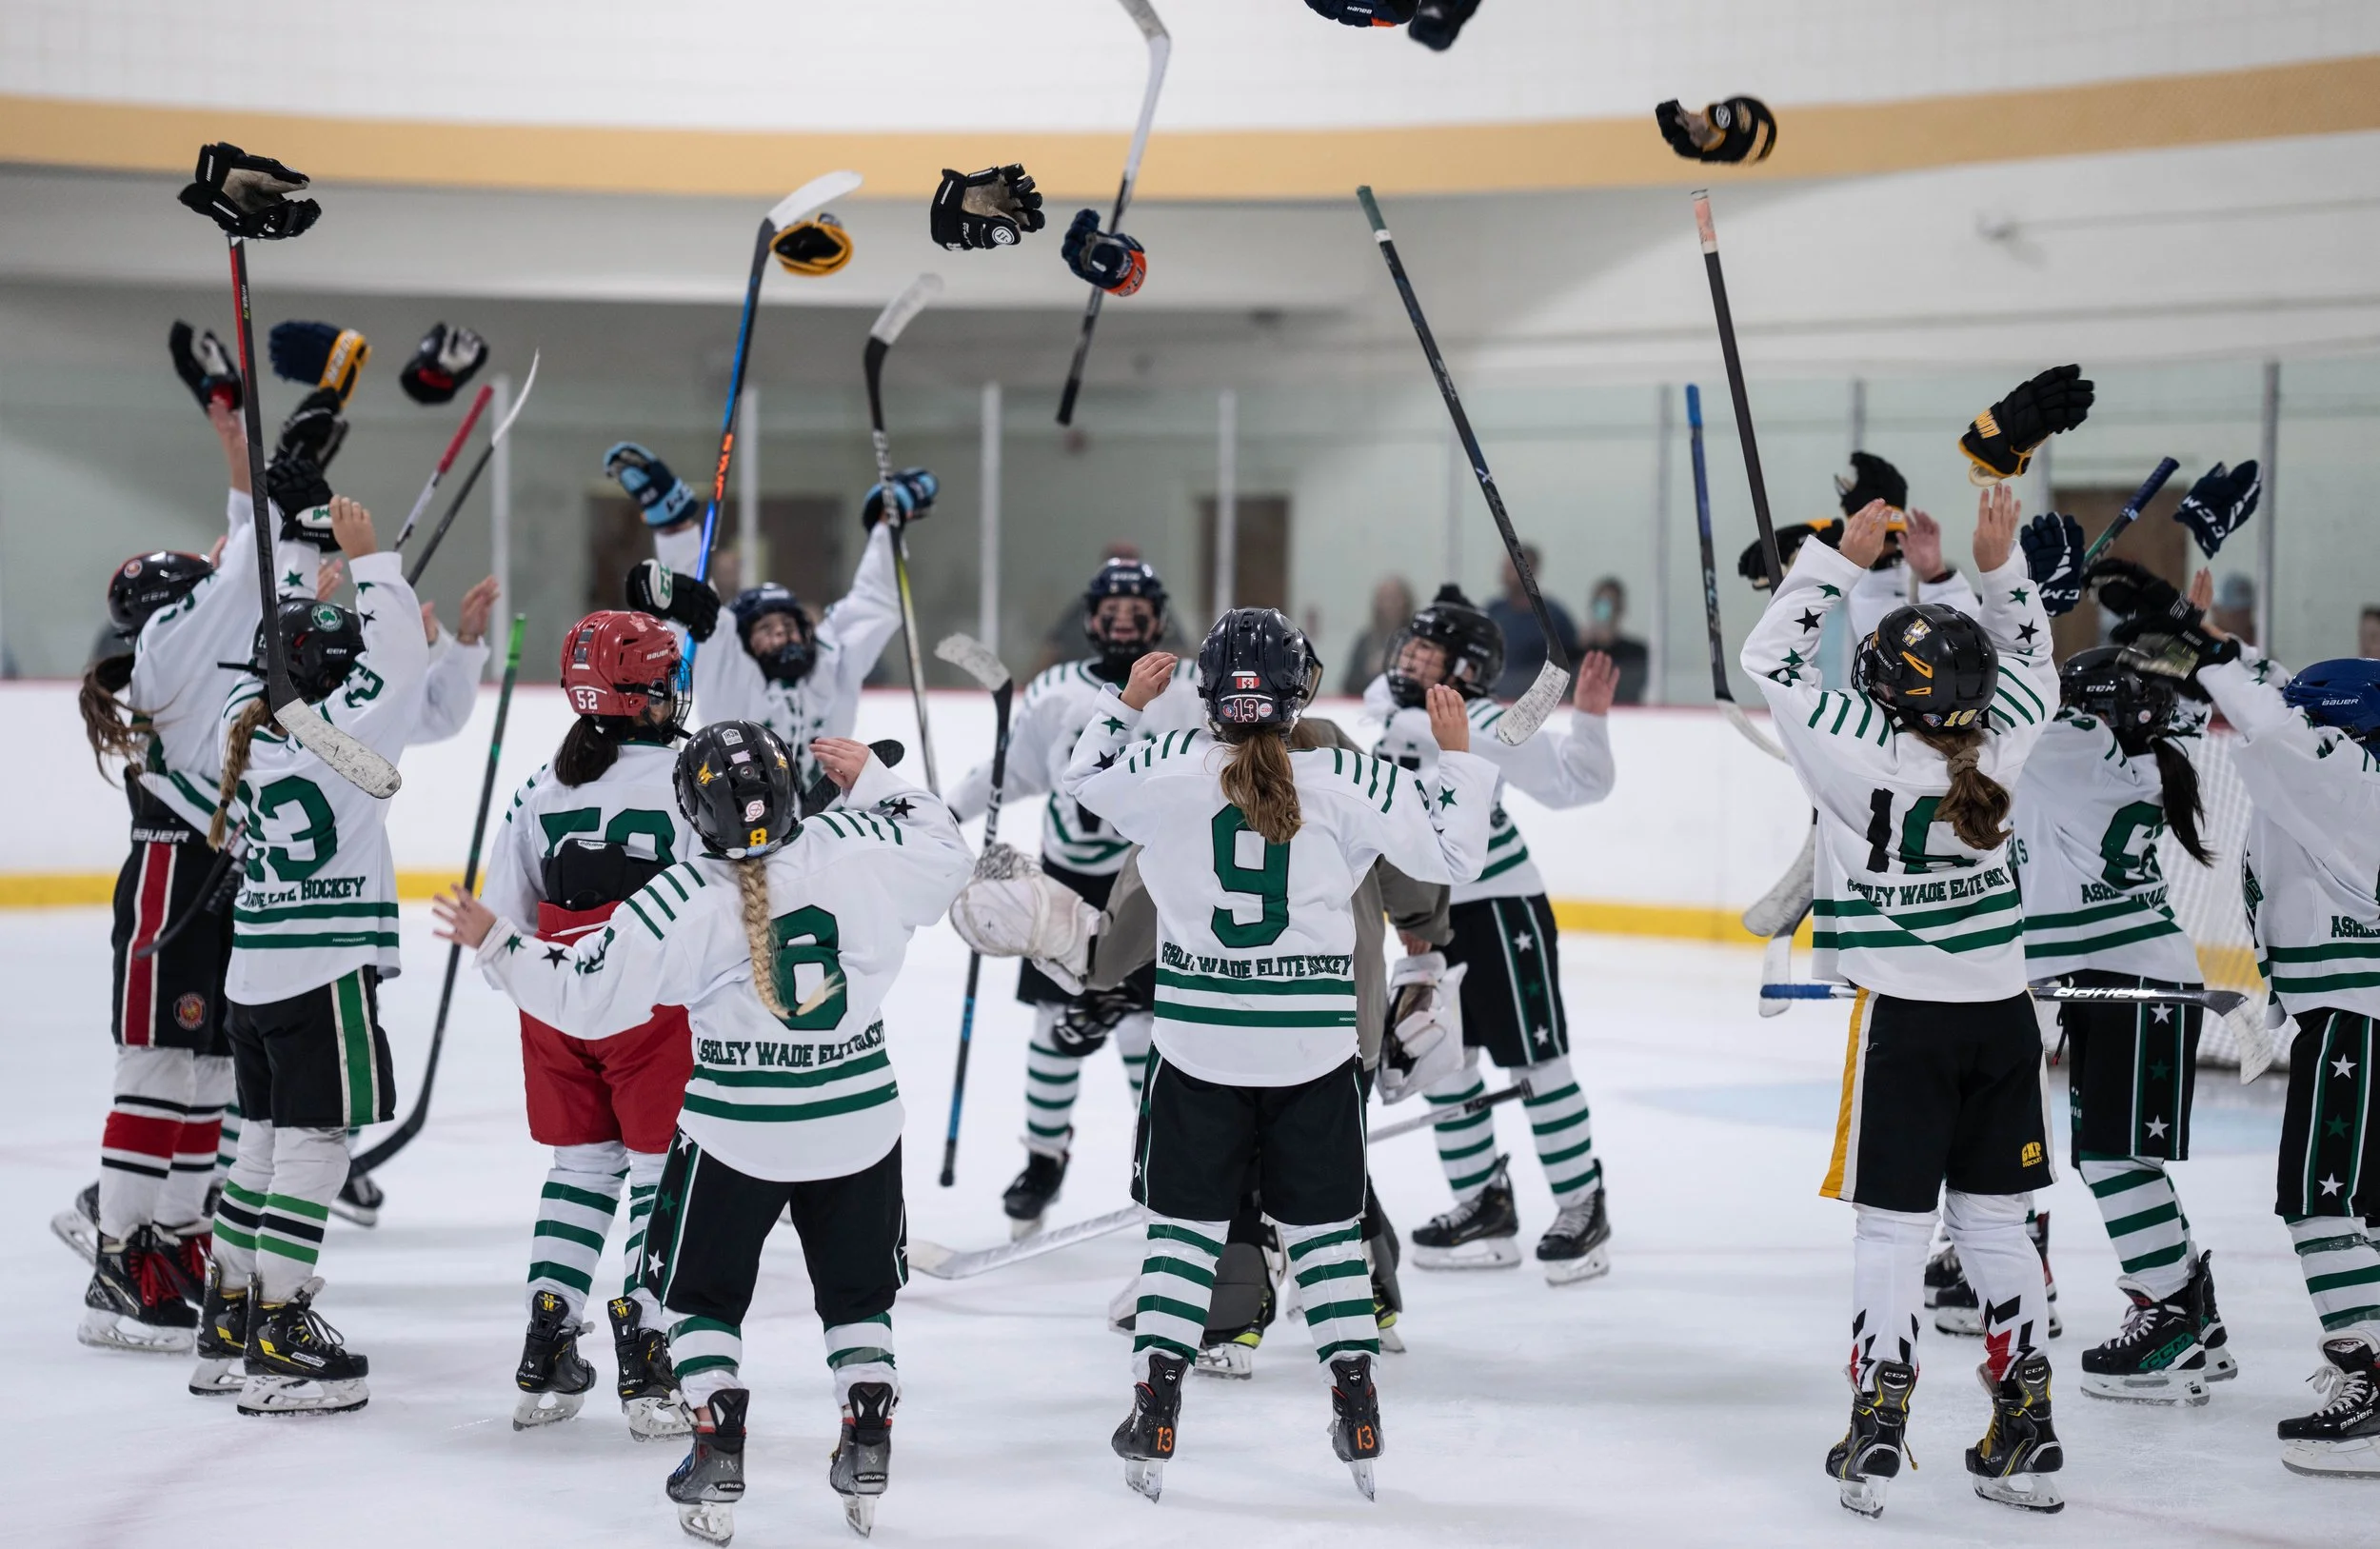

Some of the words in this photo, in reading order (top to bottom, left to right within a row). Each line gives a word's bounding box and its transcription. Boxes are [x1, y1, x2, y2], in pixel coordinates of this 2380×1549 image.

[2040, 588, 2080, 601] CM
[646, 648, 669, 661] BAUER
[2086, 685, 2117, 693] CCM
[576, 690, 598, 710] 52
[2321, 698, 2359, 706] BAUER
[1233, 698, 1259, 724] 13
[1943, 708, 1978, 727] 10
[132, 827, 190, 844] BAUER
[749, 827, 767, 846] 8
[1210, 803, 1291, 949] 9
[300, 876, 367, 901] HOCKEY
[1899, 881, 1948, 906] WADE
[1949, 873, 1986, 899] ELITE
[1197, 955, 1253, 980] WADE
[1256, 954, 1306, 978] ELITE
[755, 1041, 814, 1068] WADE
[293, 1353, 326, 1366] BAUER
[2147, 1333, 2192, 1368] CCM
[1884, 1371, 1908, 1380] CCM
[2024, 1364, 2046, 1376] CCM
[2340, 1407, 2374, 1430] BAUER
[1157, 1426, 1174, 1453] 13
[1357, 1424, 1376, 1450] 13
